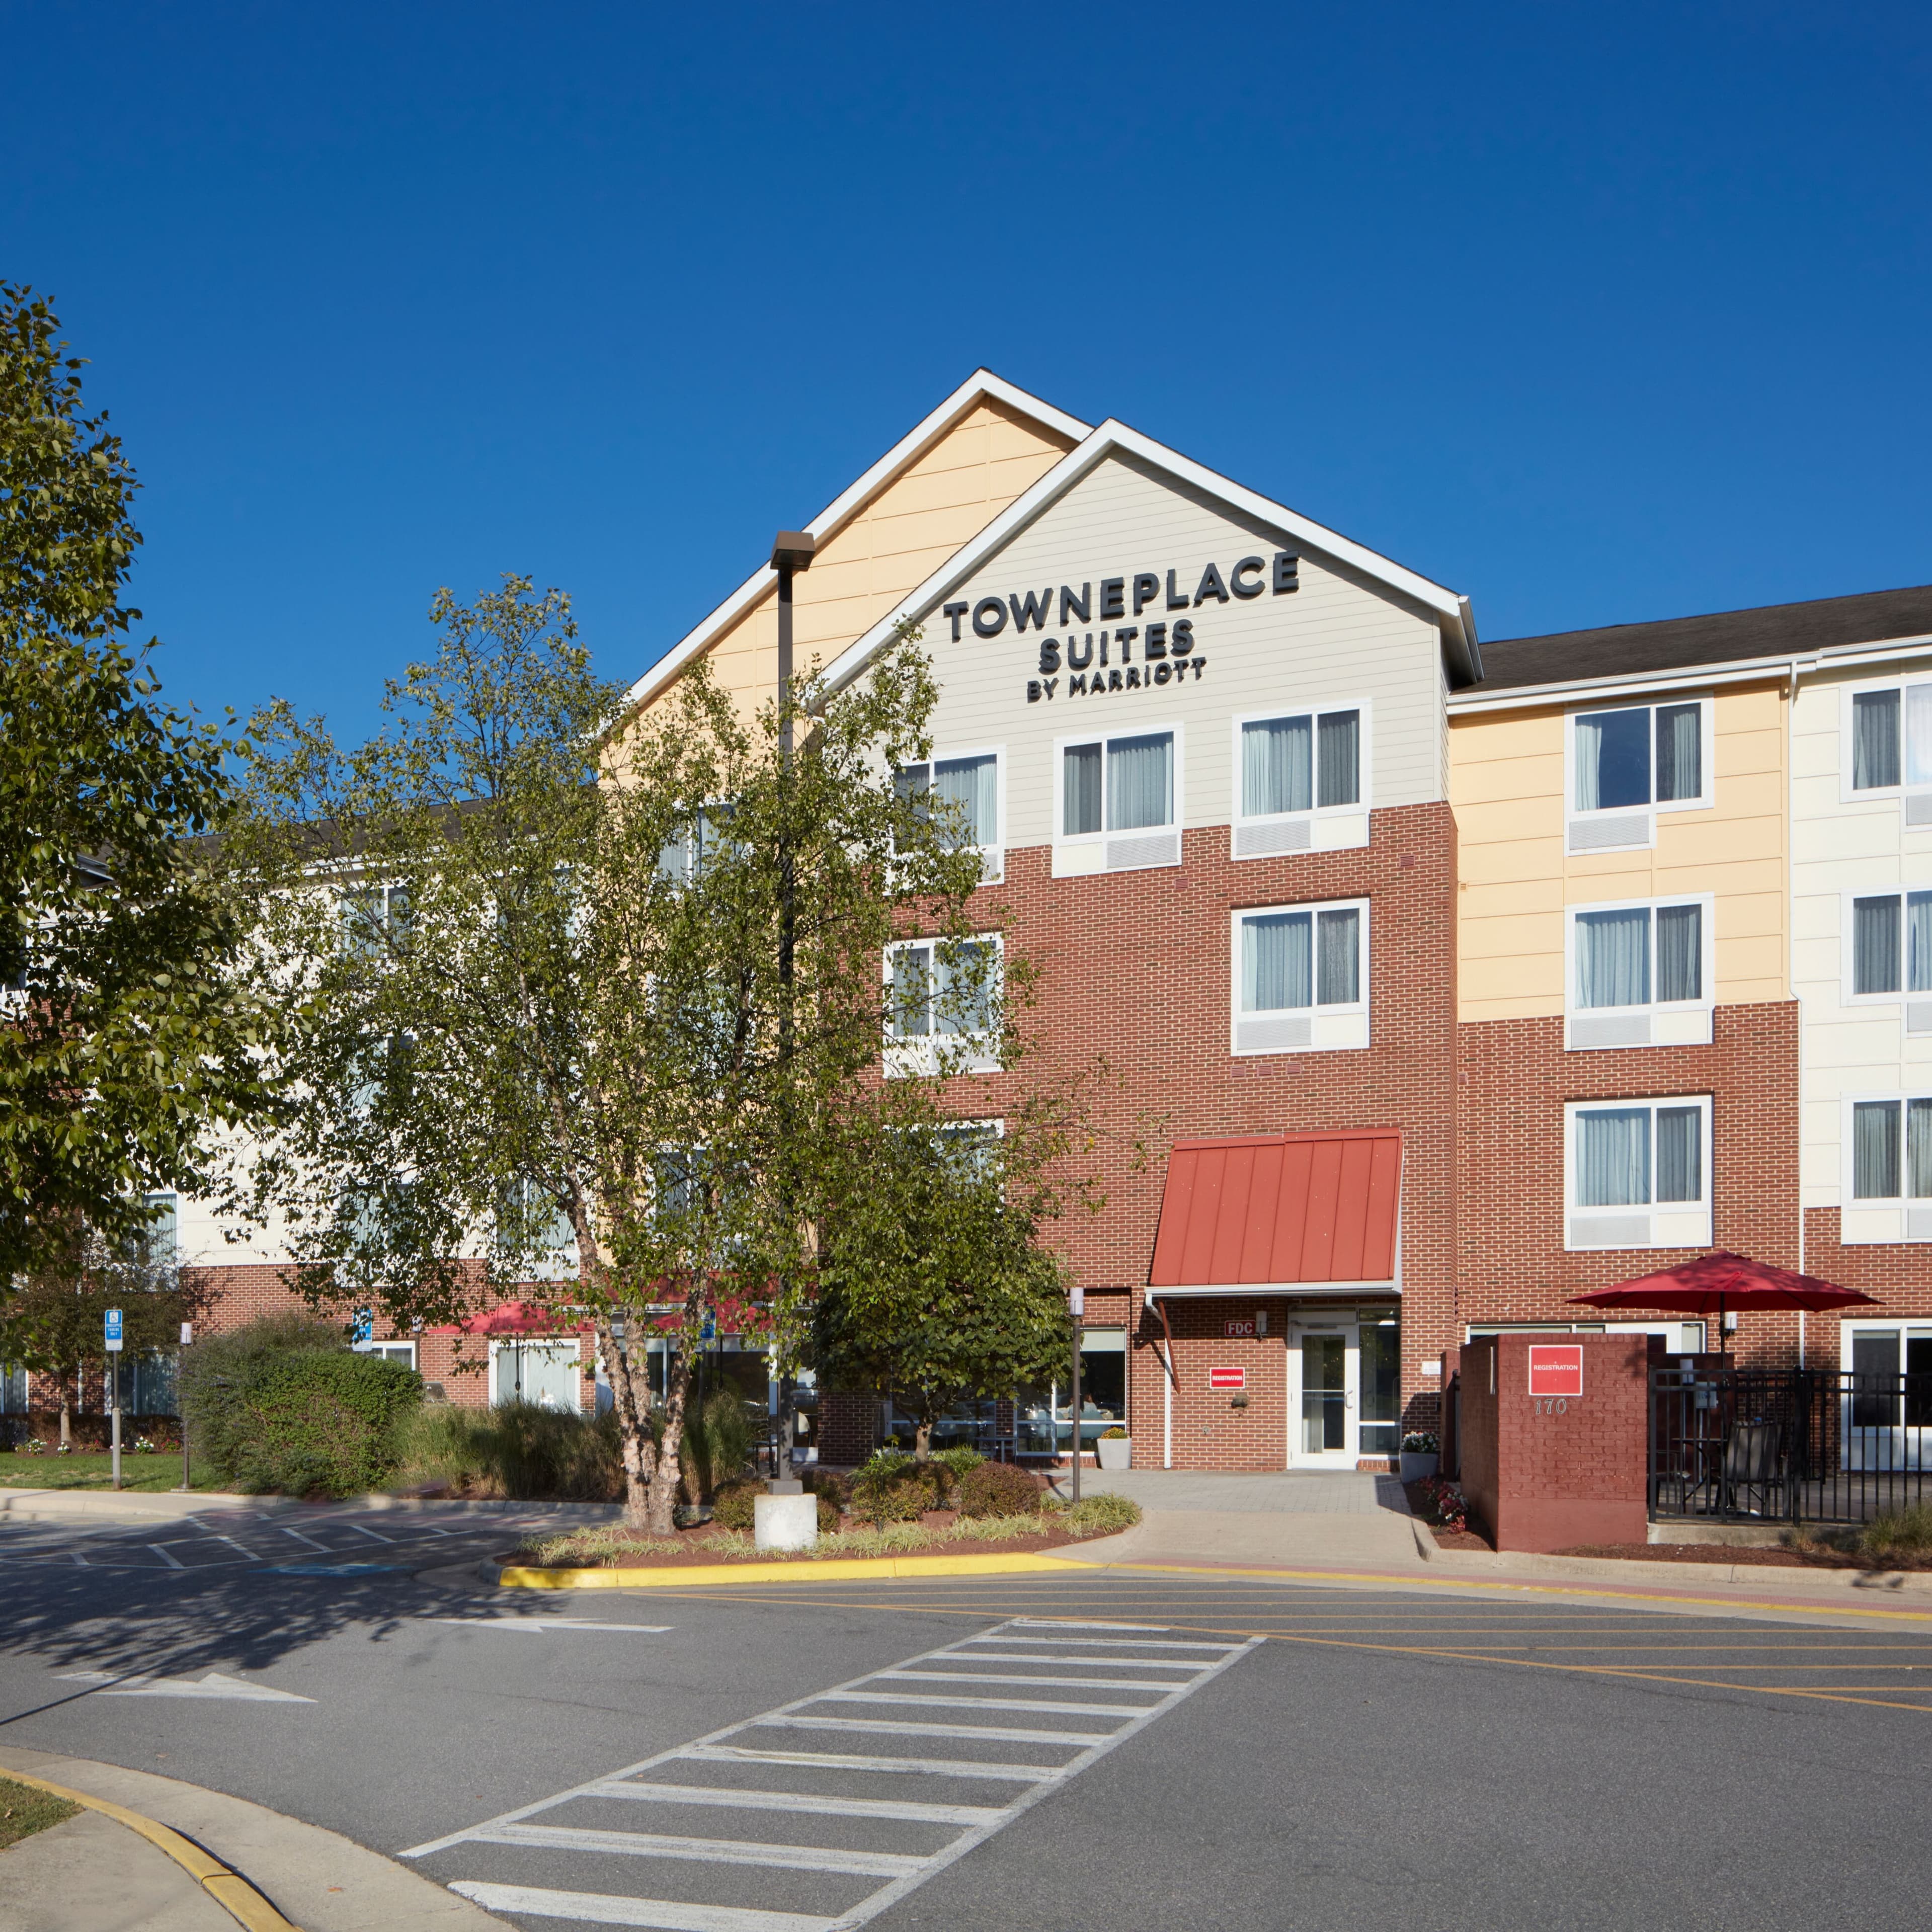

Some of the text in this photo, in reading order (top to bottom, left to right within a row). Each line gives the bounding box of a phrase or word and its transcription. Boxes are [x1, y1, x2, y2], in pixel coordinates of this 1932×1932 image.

[943, 550, 1301, 642] TOWNEPLACE
[1039, 619, 1194, 674] SUITES
[1027, 657, 1206, 702] BY MARRIOTT
[1228, 1322, 1252, 1334] FDC
[1536, 1398, 1567, 1415] 170
